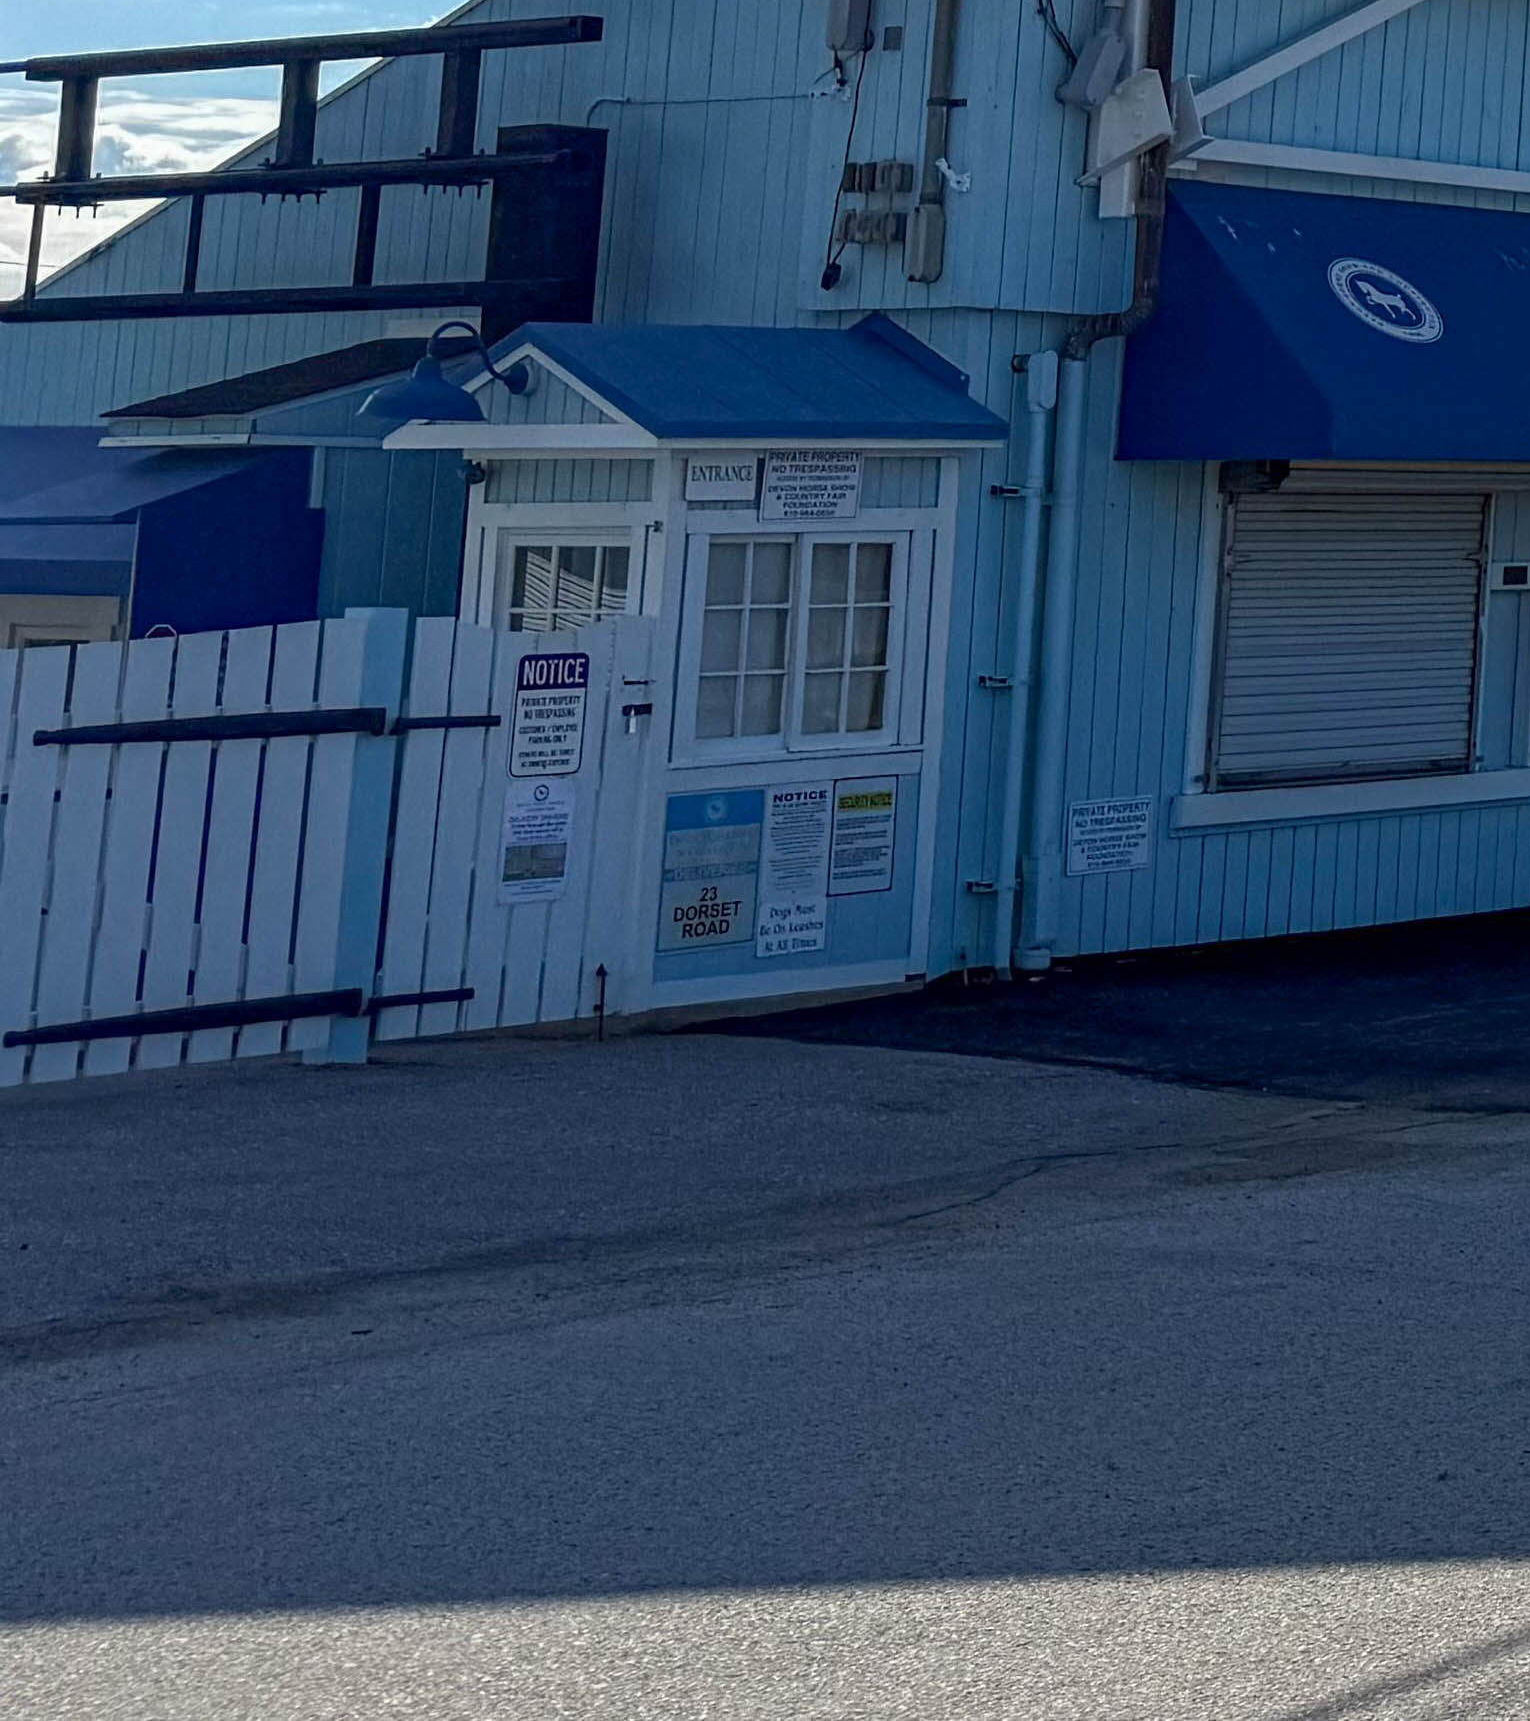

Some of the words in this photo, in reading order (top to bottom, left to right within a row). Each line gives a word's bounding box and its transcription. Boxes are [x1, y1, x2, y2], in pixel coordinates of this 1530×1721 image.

[769, 451, 811, 464] PRIVATE
[812, 451, 860, 463] PROPERTY
[691, 464, 753, 482] ENTRANCE
[771, 464, 788, 474] NO
[789, 464, 857, 474] TRESPASSING
[768, 484, 797, 493] DEVON
[799, 484, 828, 493] HORSE
[784, 493, 825, 501] COUNTRY
[782, 501, 838, 509] FOUNDATION
[523, 658, 586, 686] NOTICE
[521, 697, 547, 707] PRIVATE
[548, 695, 581, 706] PROPERTY
[524, 709, 533, 720] NO
[534, 707, 575, 719] TRESPASSING
[772, 790, 828, 804] NOTICE
[1072, 806, 1105, 818] PRIVATE
[1106, 801, 1152, 815] PROPERTY
[1089, 813, 1146, 826] TRESPASSING
[699, 886, 718, 902] 23
[673, 900, 743, 923] DORSET
[770, 908, 792, 920] Dogs
[796, 904, 817, 914] Must
[681, 920, 730, 939] ROAD
[789, 921, 823, 933] Leashes
[791, 938, 817, 949] Times
